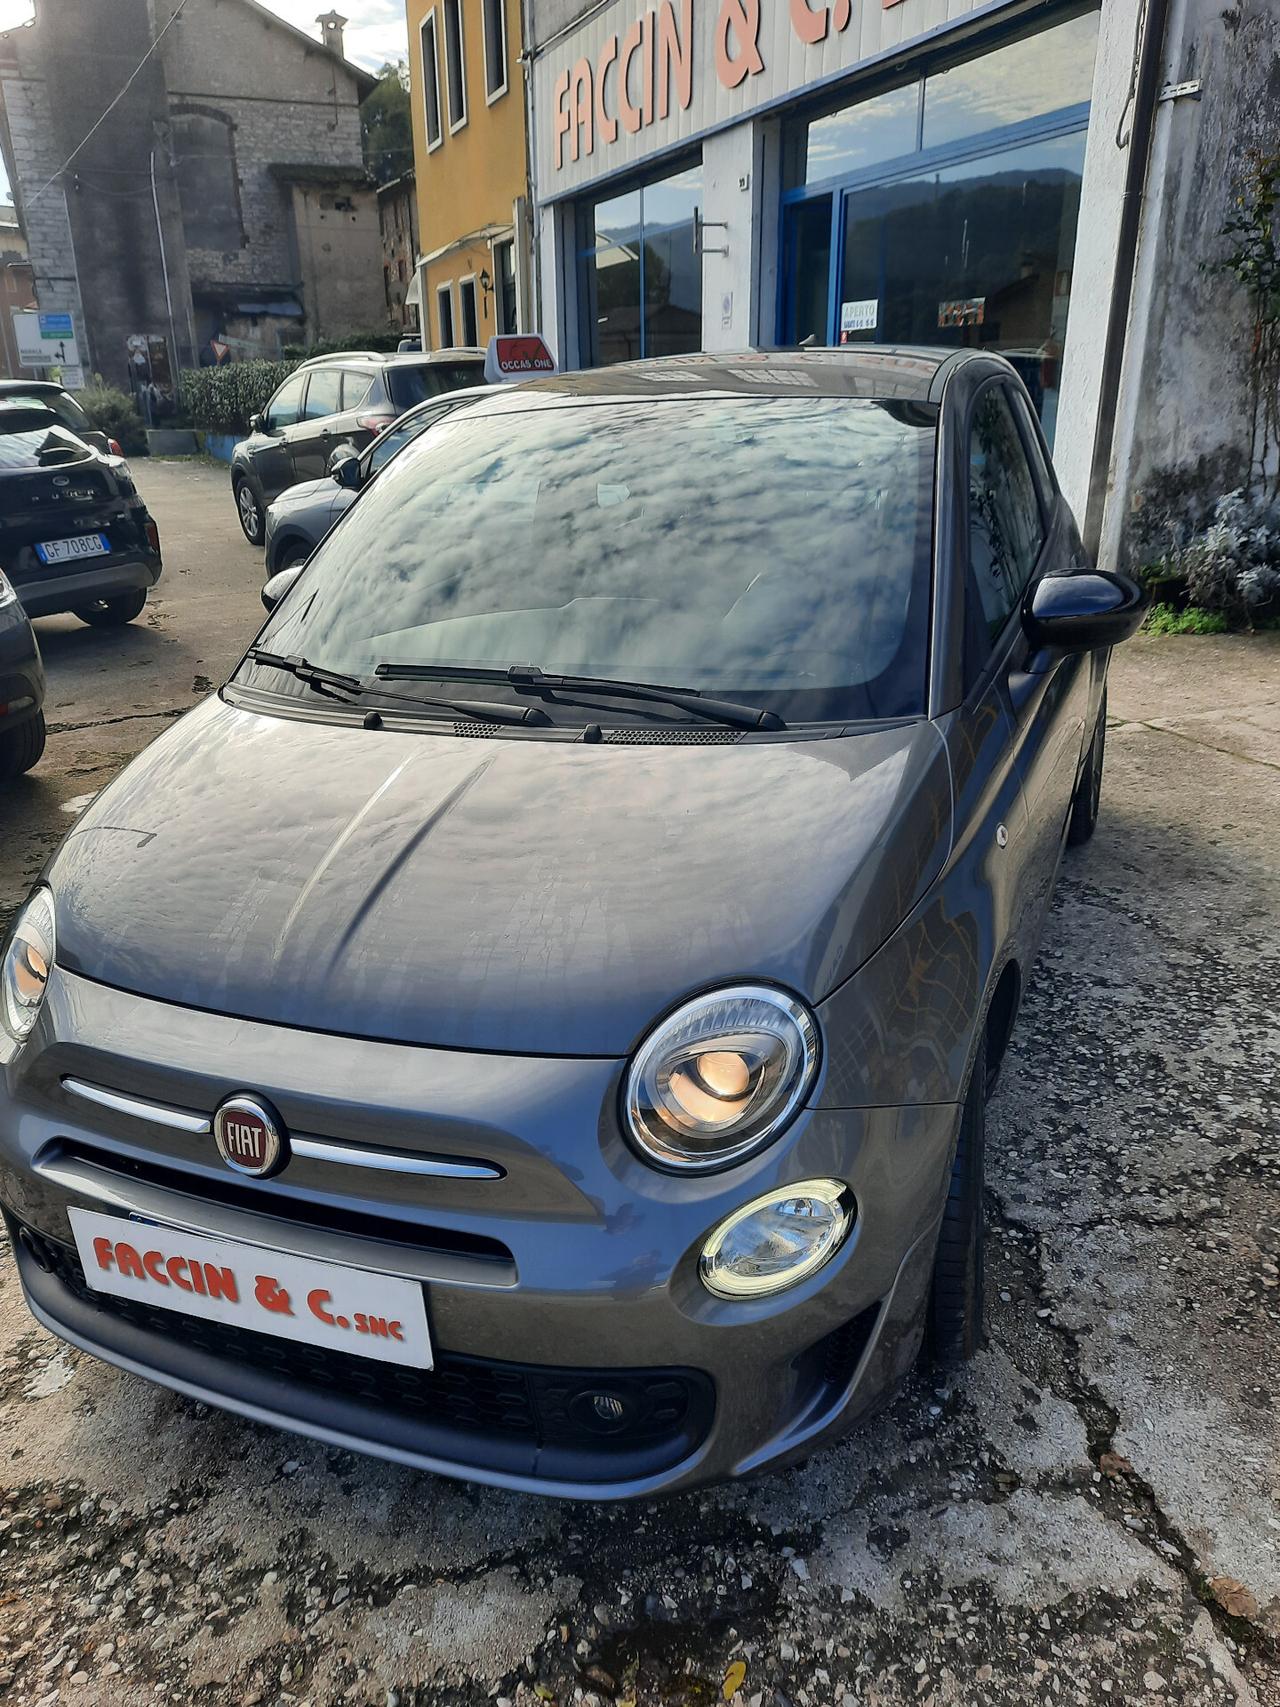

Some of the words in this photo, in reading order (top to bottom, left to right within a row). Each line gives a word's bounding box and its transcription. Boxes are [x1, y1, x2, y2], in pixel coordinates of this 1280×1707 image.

[555, 0, 693, 169] FACCIN
[715, 0, 764, 89] &
[844, 304, 874, 318] APERTO
[501, 359, 552, 370] OCCASONE
[227, 1121, 263, 1158] FIAT
[93, 1236, 239, 1303] FACCIN
[254, 1275, 295, 1317] &
